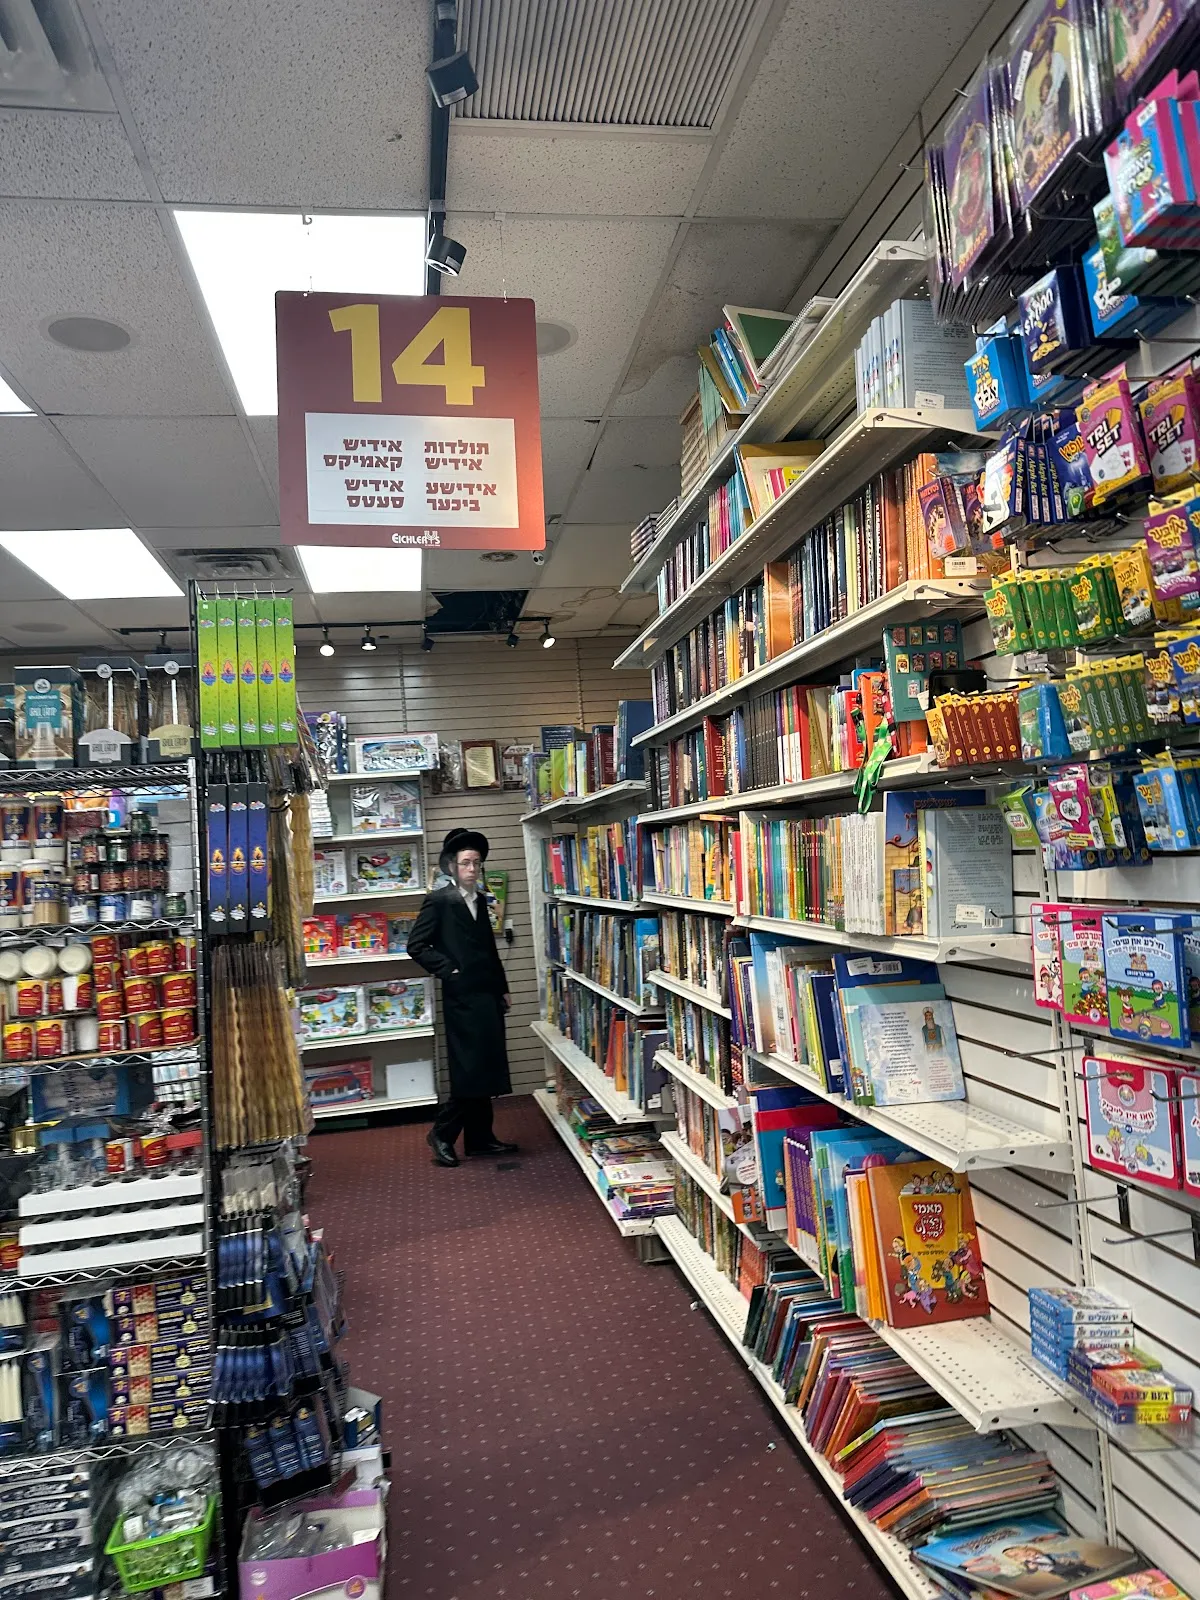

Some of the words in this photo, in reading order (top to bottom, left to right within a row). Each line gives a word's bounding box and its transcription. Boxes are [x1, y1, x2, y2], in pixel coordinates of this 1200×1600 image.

[328, 303, 486, 405] 14
[1087, 420, 1109, 446] TRI
[1149, 417, 1172, 442] TRI
[1158, 421, 1184, 451] SET
[343, 439, 403, 452] אידיש
[1096, 424, 1120, 454] SET
[424, 440, 490, 455] תולדות
[323, 454, 403, 472] קאמיקס
[425, 457, 483, 471] אידיש
[344, 478, 404, 492] אידיש
[425, 482, 497, 496] אידישע
[346, 495, 405, 509] סעטס
[426, 498, 481, 512] ביכער
[1161, 536, 1181, 547] חכם
[1112, 937, 1130, 946] שימי
[1132, 937, 1143, 946] און
[913, 1203, 943, 1214] מאמי
[1088, 1314, 1119, 1322] ירושלים
[1123, 1391, 1147, 1401] ALEF
[1151, 1391, 1170, 1401] BET
